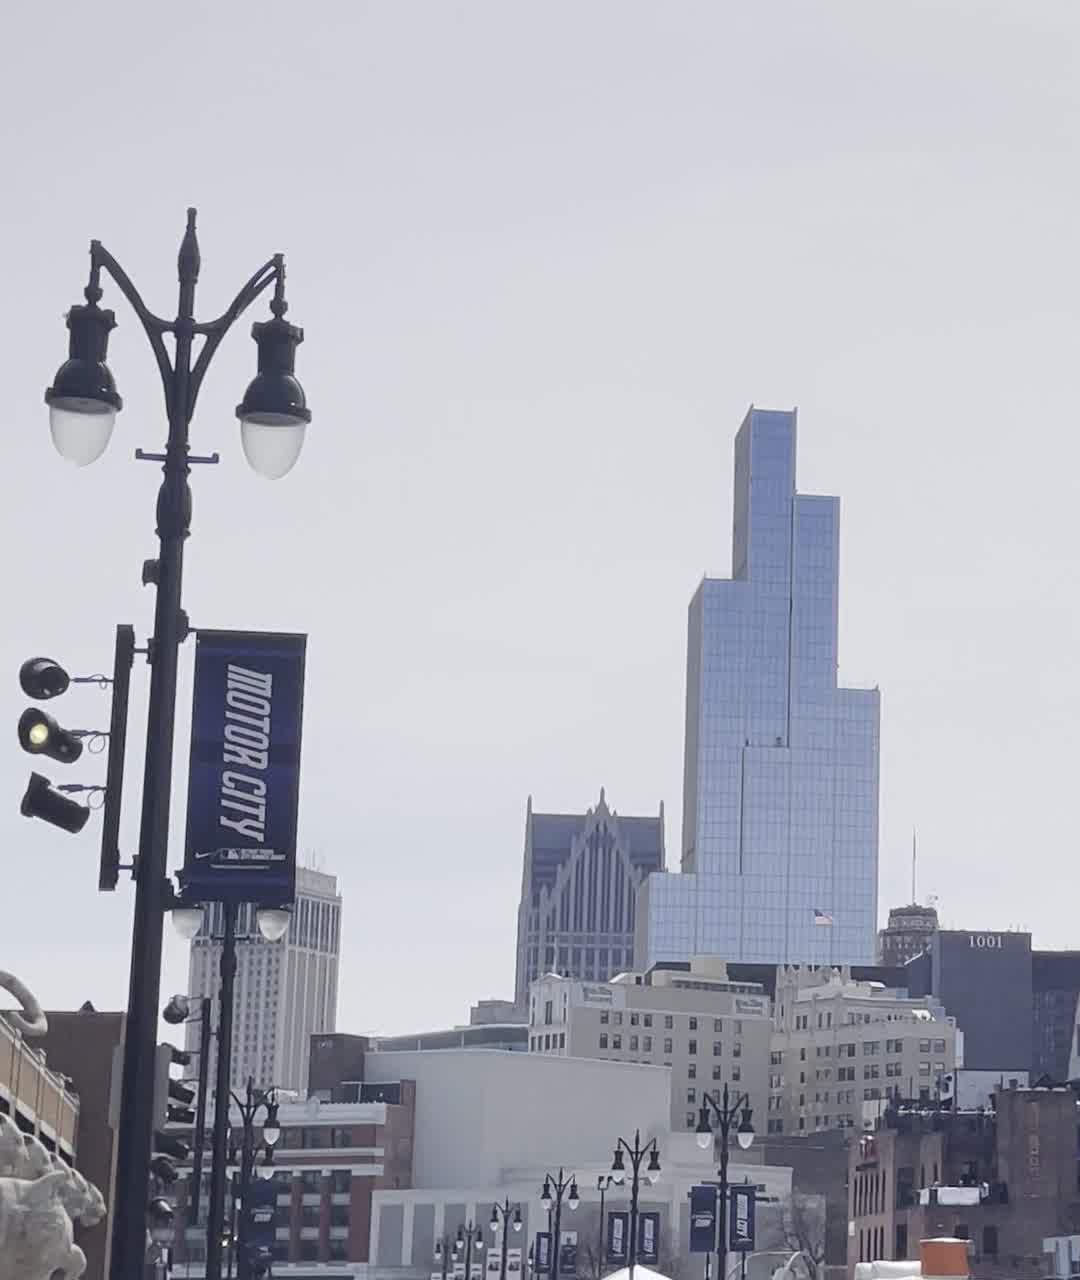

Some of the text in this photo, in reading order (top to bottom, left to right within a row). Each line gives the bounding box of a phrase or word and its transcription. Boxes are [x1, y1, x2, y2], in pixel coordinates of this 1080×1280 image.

[223, 664, 272, 770] MOTOR
[220, 770, 267, 842] CITY
[969, 935, 1002, 949] 1001
